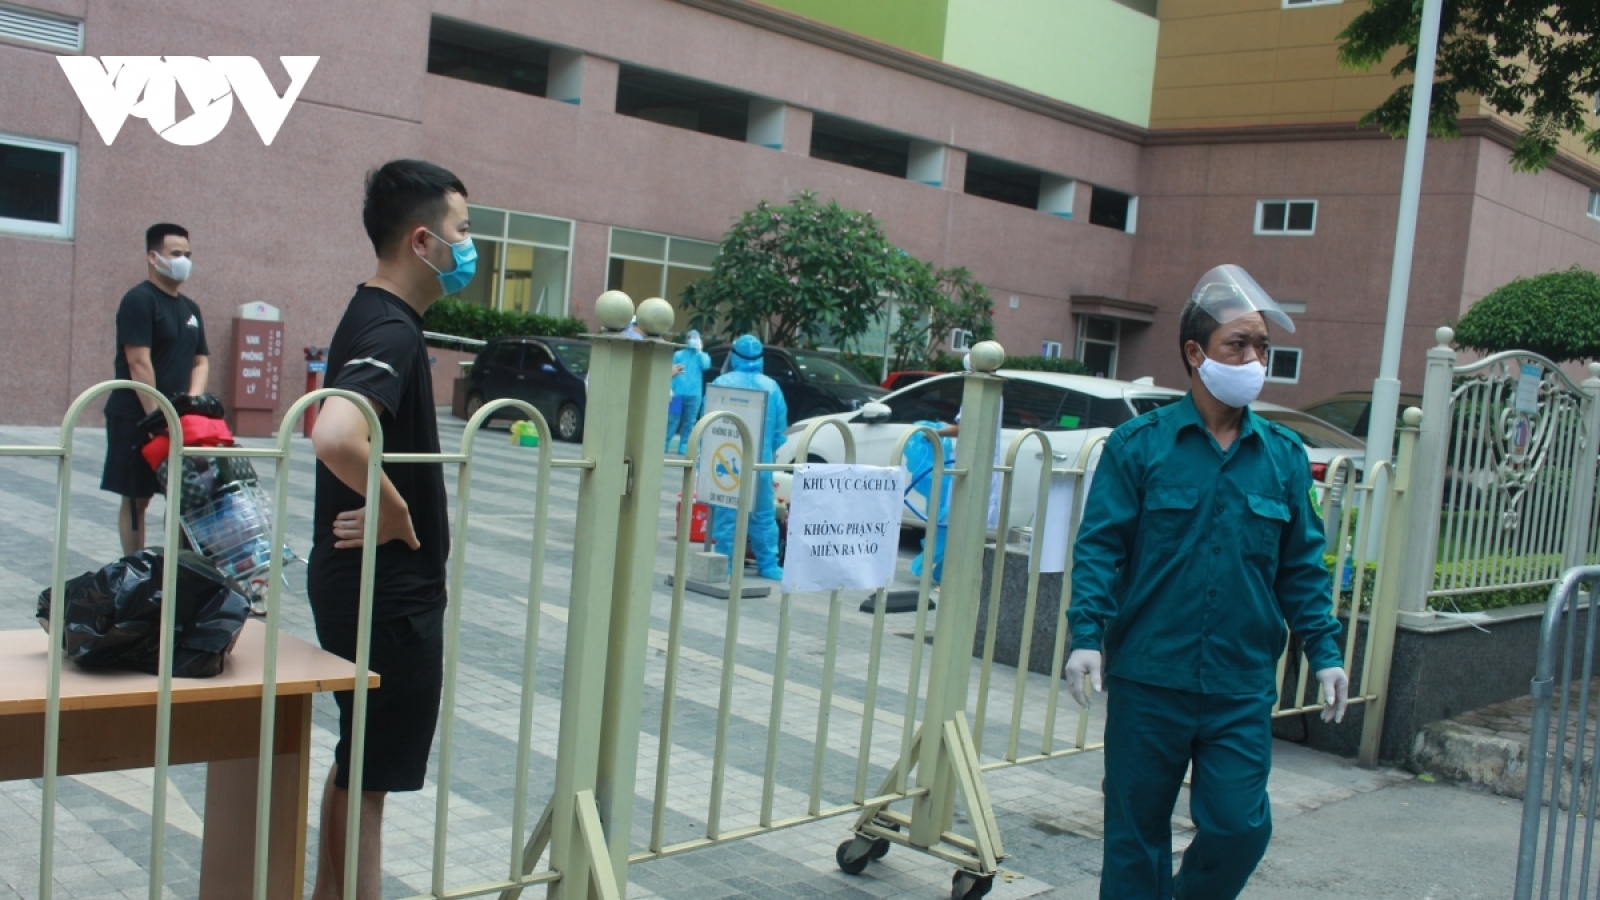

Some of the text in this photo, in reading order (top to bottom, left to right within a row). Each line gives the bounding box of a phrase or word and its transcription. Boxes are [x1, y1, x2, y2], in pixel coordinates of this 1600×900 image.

[803, 476, 898, 492] KHU VỰC CÁCH LY
[804, 520, 844, 536] KHÔNG
[875, 521, 890, 537] SỰ
[842, 544, 855, 556] RA
[858, 540, 878, 555] VÀO
